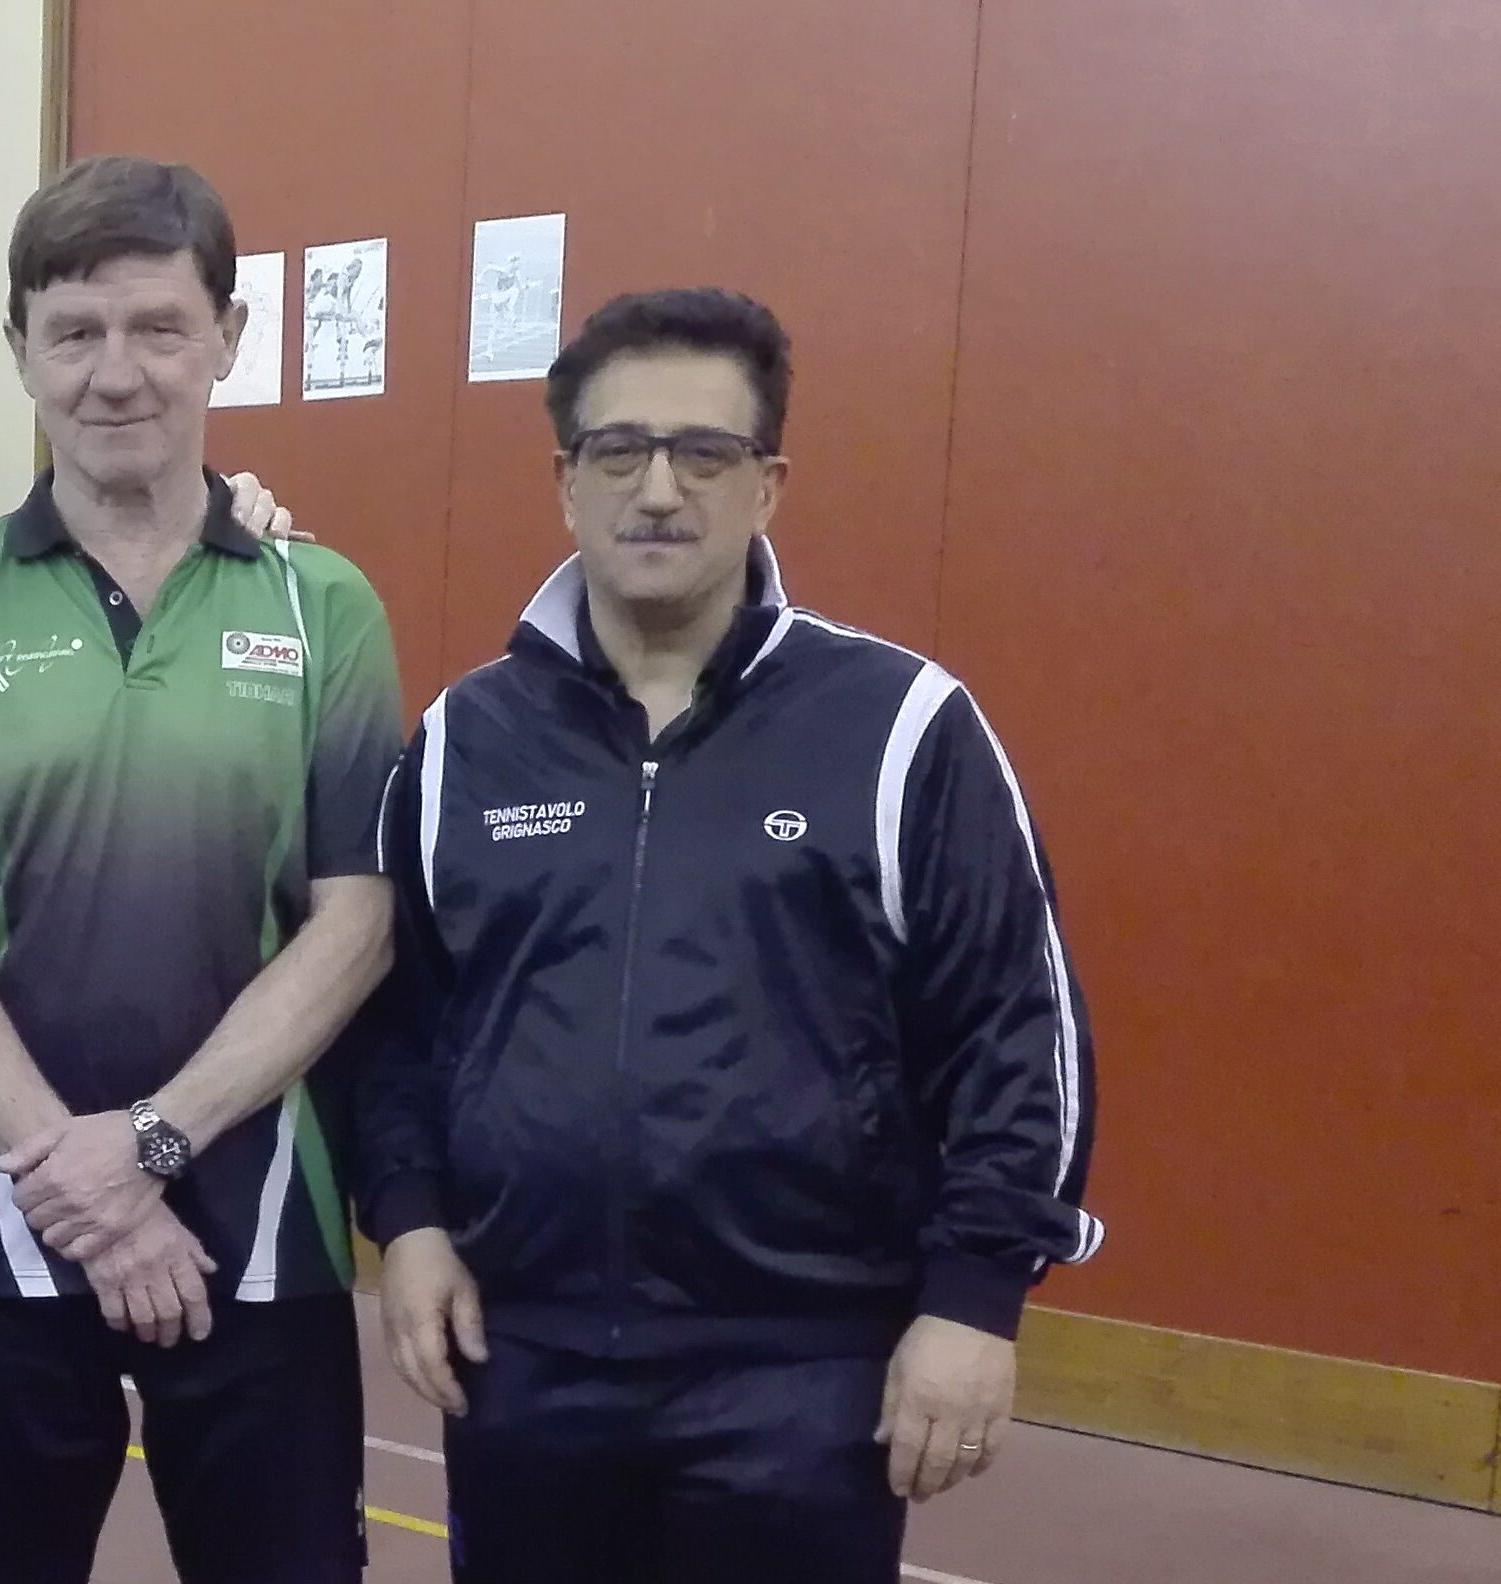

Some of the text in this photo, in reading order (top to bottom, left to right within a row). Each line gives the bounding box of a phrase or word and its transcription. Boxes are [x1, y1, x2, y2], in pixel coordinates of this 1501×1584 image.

[249, 644, 299, 661] ADMO
[483, 801, 586, 826] TENNISTAVOLO
[492, 818, 571, 842] GRIGNASCO
